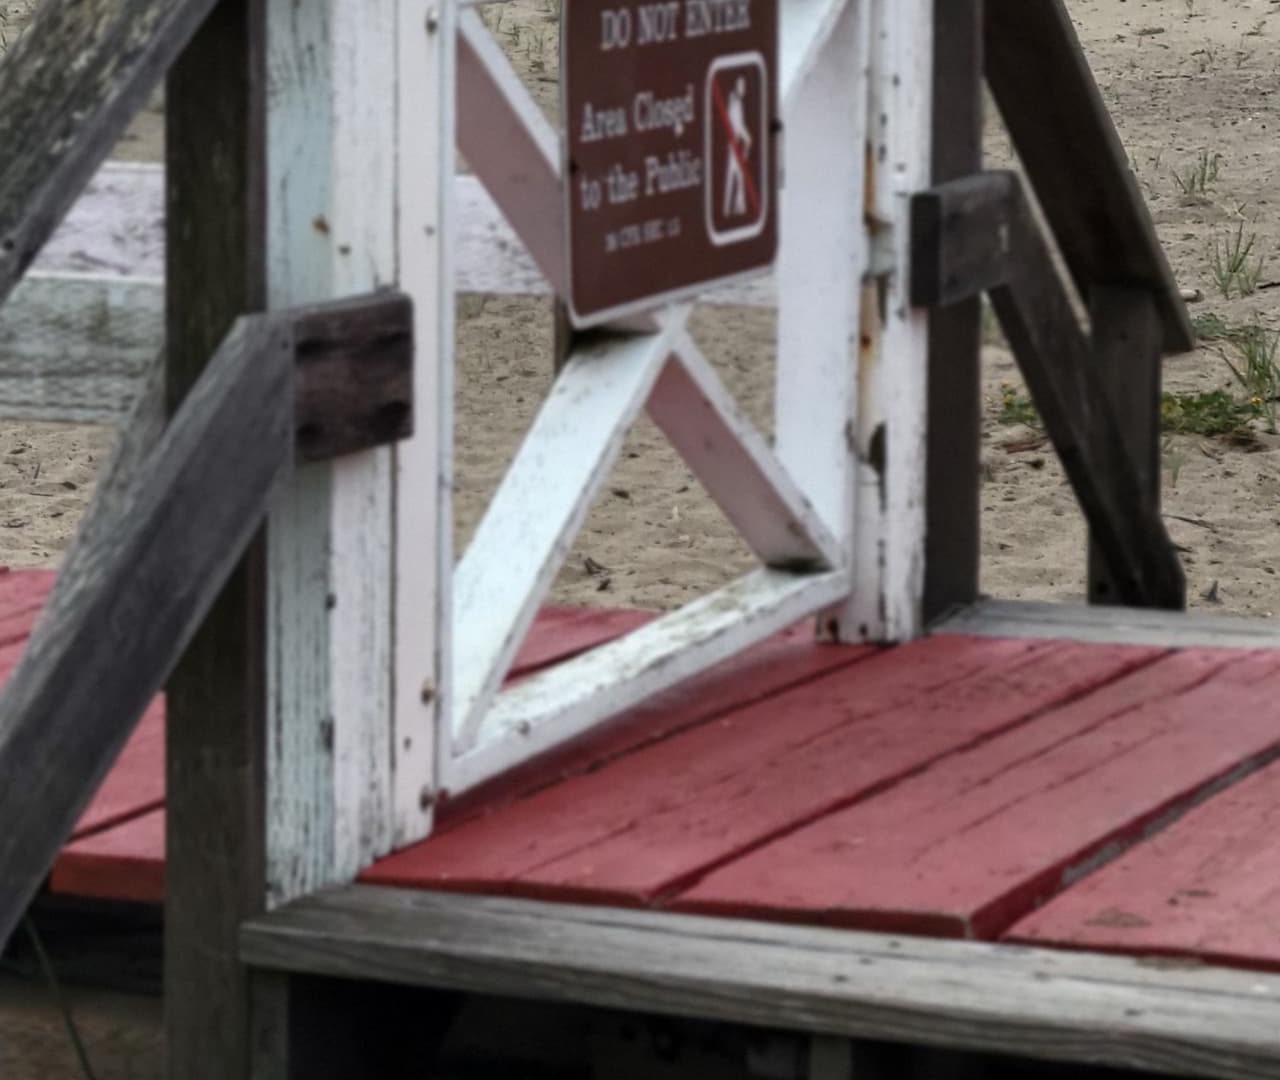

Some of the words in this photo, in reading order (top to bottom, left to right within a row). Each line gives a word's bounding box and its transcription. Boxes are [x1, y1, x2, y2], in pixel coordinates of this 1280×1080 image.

[600, 7, 631, 51] DO
[637, 0, 680, 45] NOT
[580, 102, 627, 142] Area
[634, 84, 694, 132] Closed
[580, 174, 601, 211] to
[605, 163, 638, 204] the
[644, 149, 702, 197] Public
